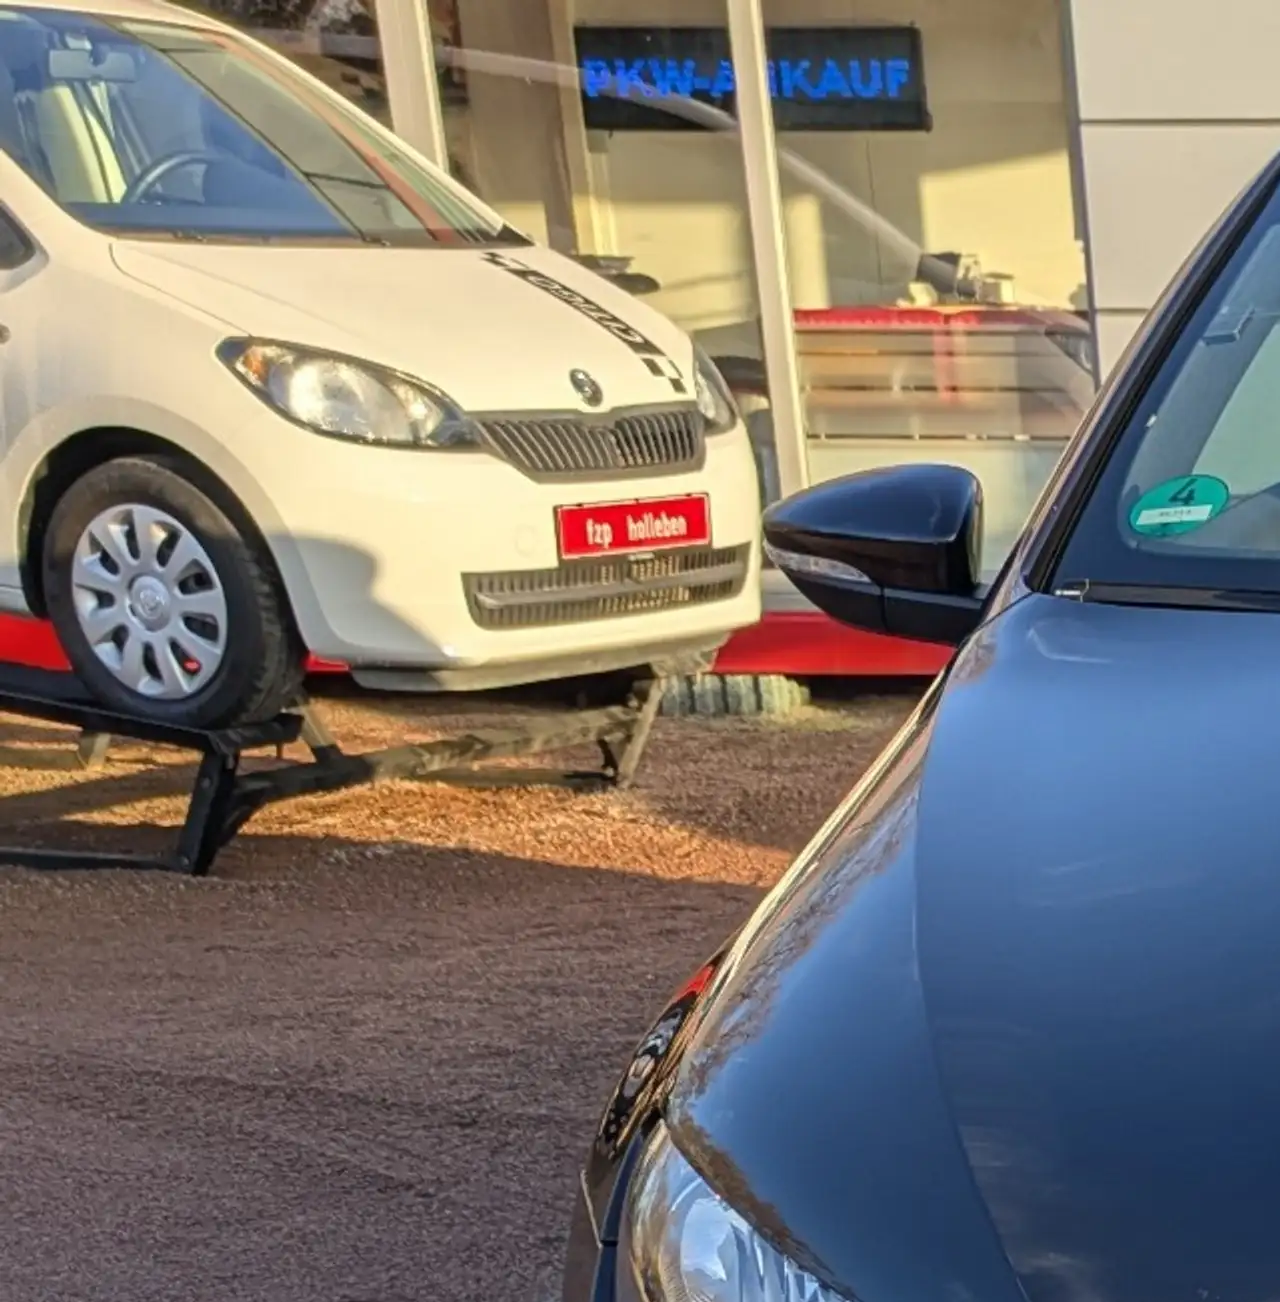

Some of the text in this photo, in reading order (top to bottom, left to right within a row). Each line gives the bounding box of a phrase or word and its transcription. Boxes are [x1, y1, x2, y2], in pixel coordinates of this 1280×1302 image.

[583, 58, 909, 98] PKW-AKAUF
[1168, 478, 1198, 505] 4
[585, 511, 688, 549] fzp holleben
